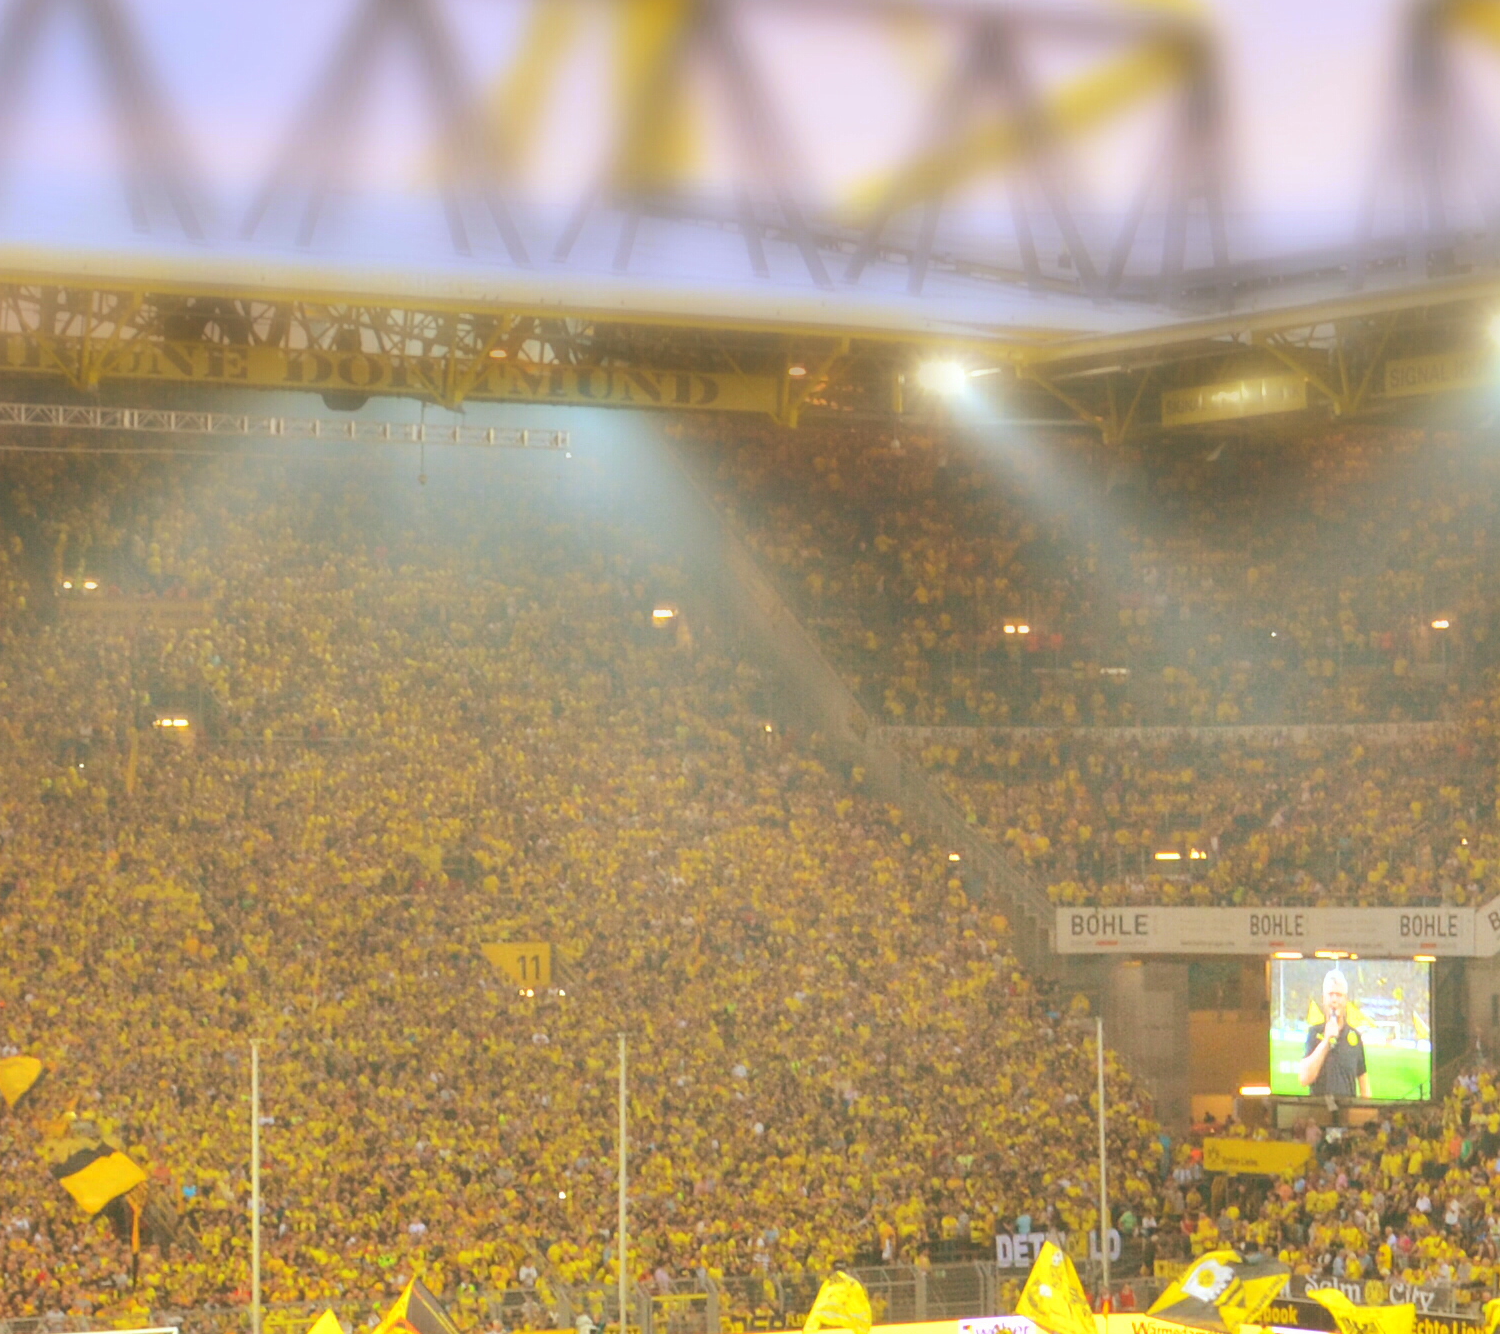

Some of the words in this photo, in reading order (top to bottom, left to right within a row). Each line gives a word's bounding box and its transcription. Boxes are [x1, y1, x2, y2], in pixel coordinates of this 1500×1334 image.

[1070, 913, 1149, 937] BOHLE
[1250, 913, 1305, 937] BOHLE
[1399, 914, 1459, 939] BOHLE
